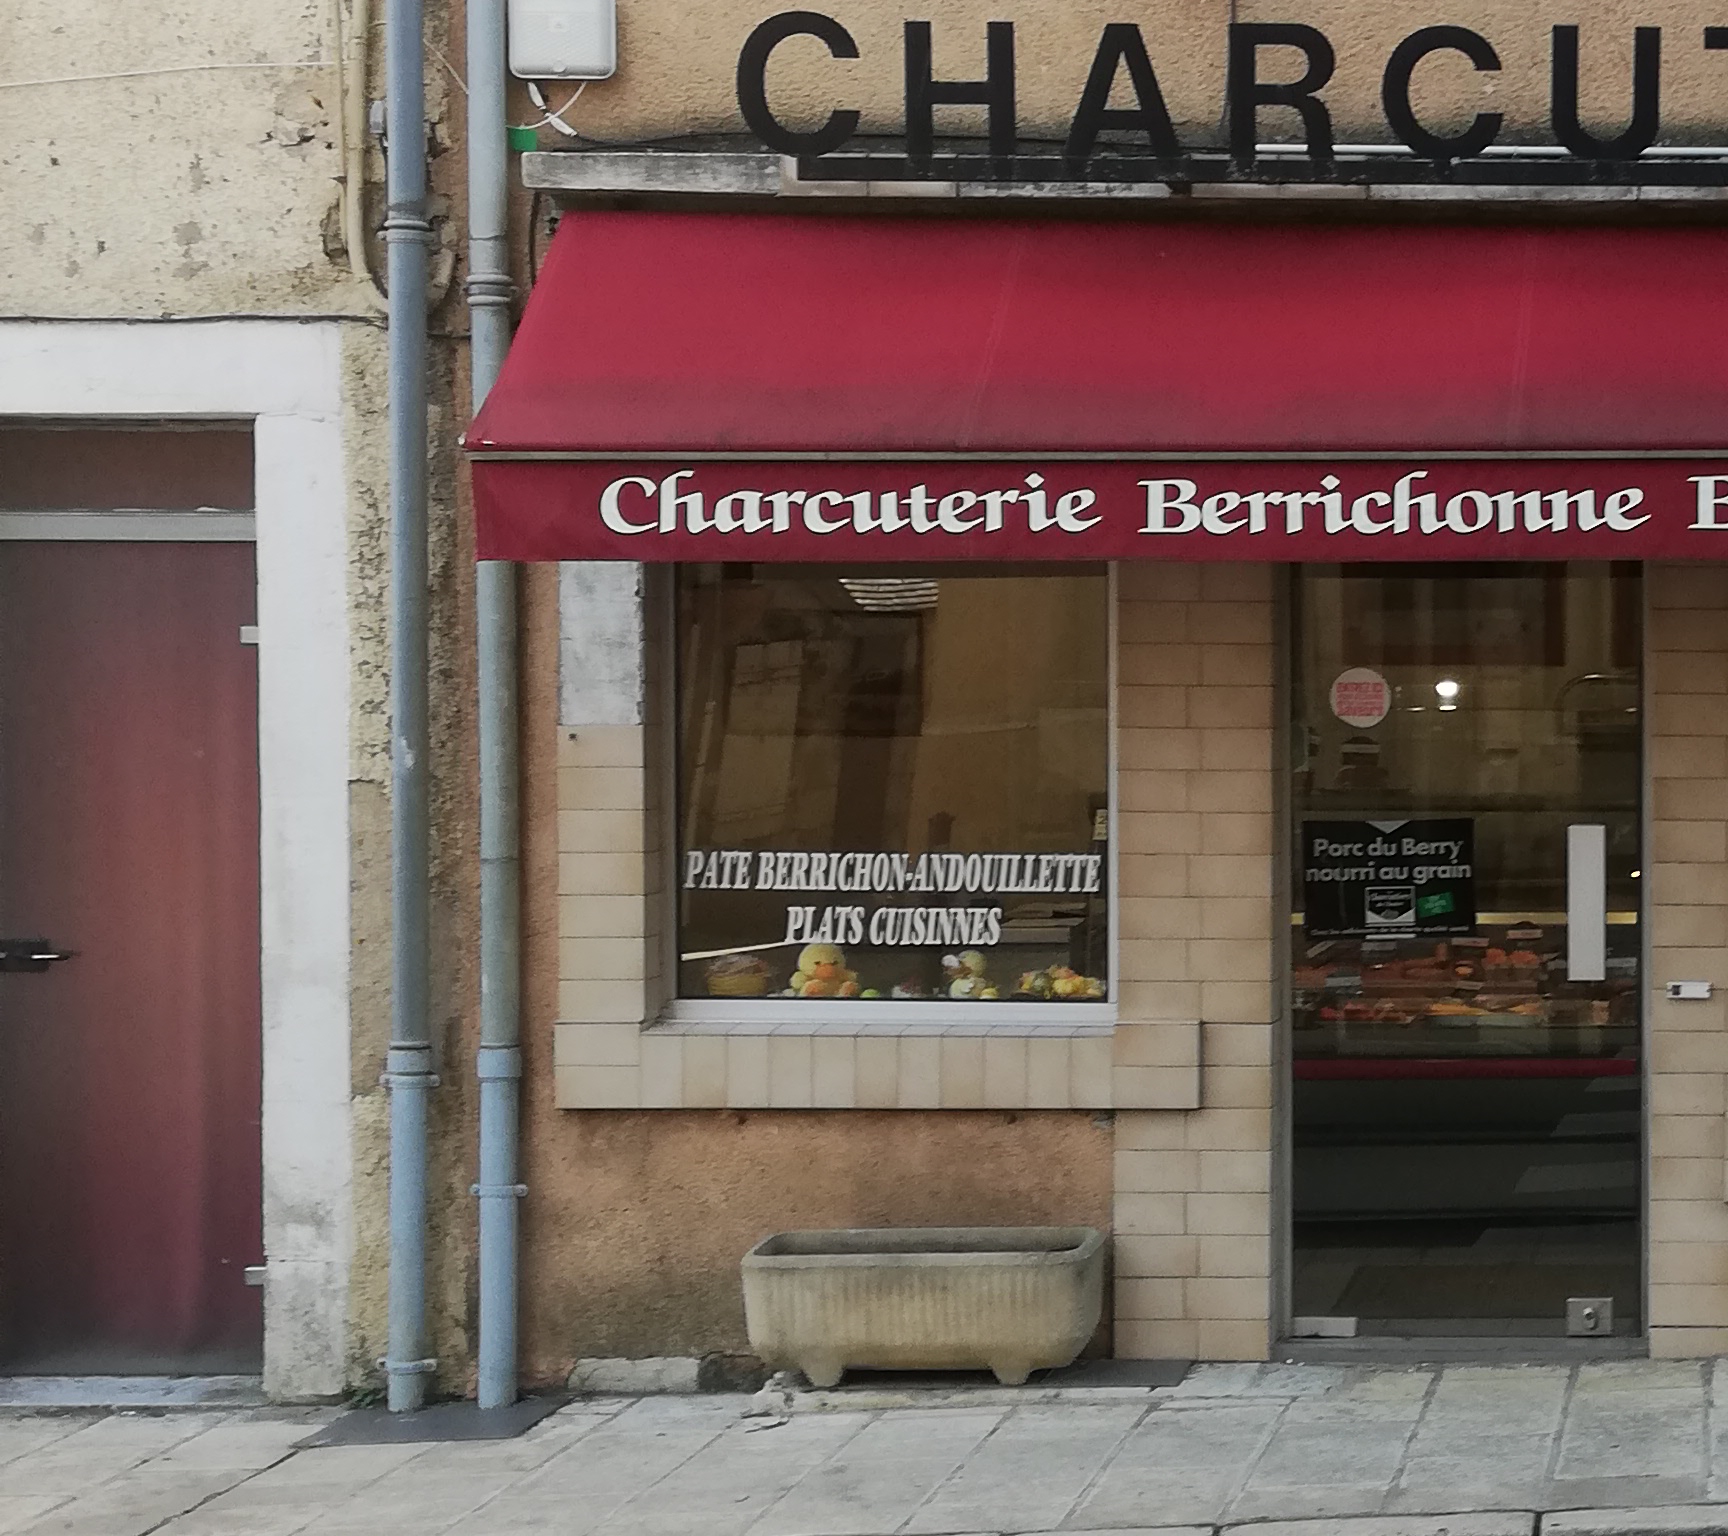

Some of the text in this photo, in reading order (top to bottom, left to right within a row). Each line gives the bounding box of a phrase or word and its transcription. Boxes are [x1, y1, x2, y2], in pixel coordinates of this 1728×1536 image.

[598, 468, 1104, 537] Charcuterie
[1136, 469, 1653, 537] Berrichonne
[1313, 836, 1464, 861] Porc du Berry
[682, 850, 753, 890] PATE
[1305, 859, 1472, 885] nourri au grain
[785, 906, 865, 945] PLATS
